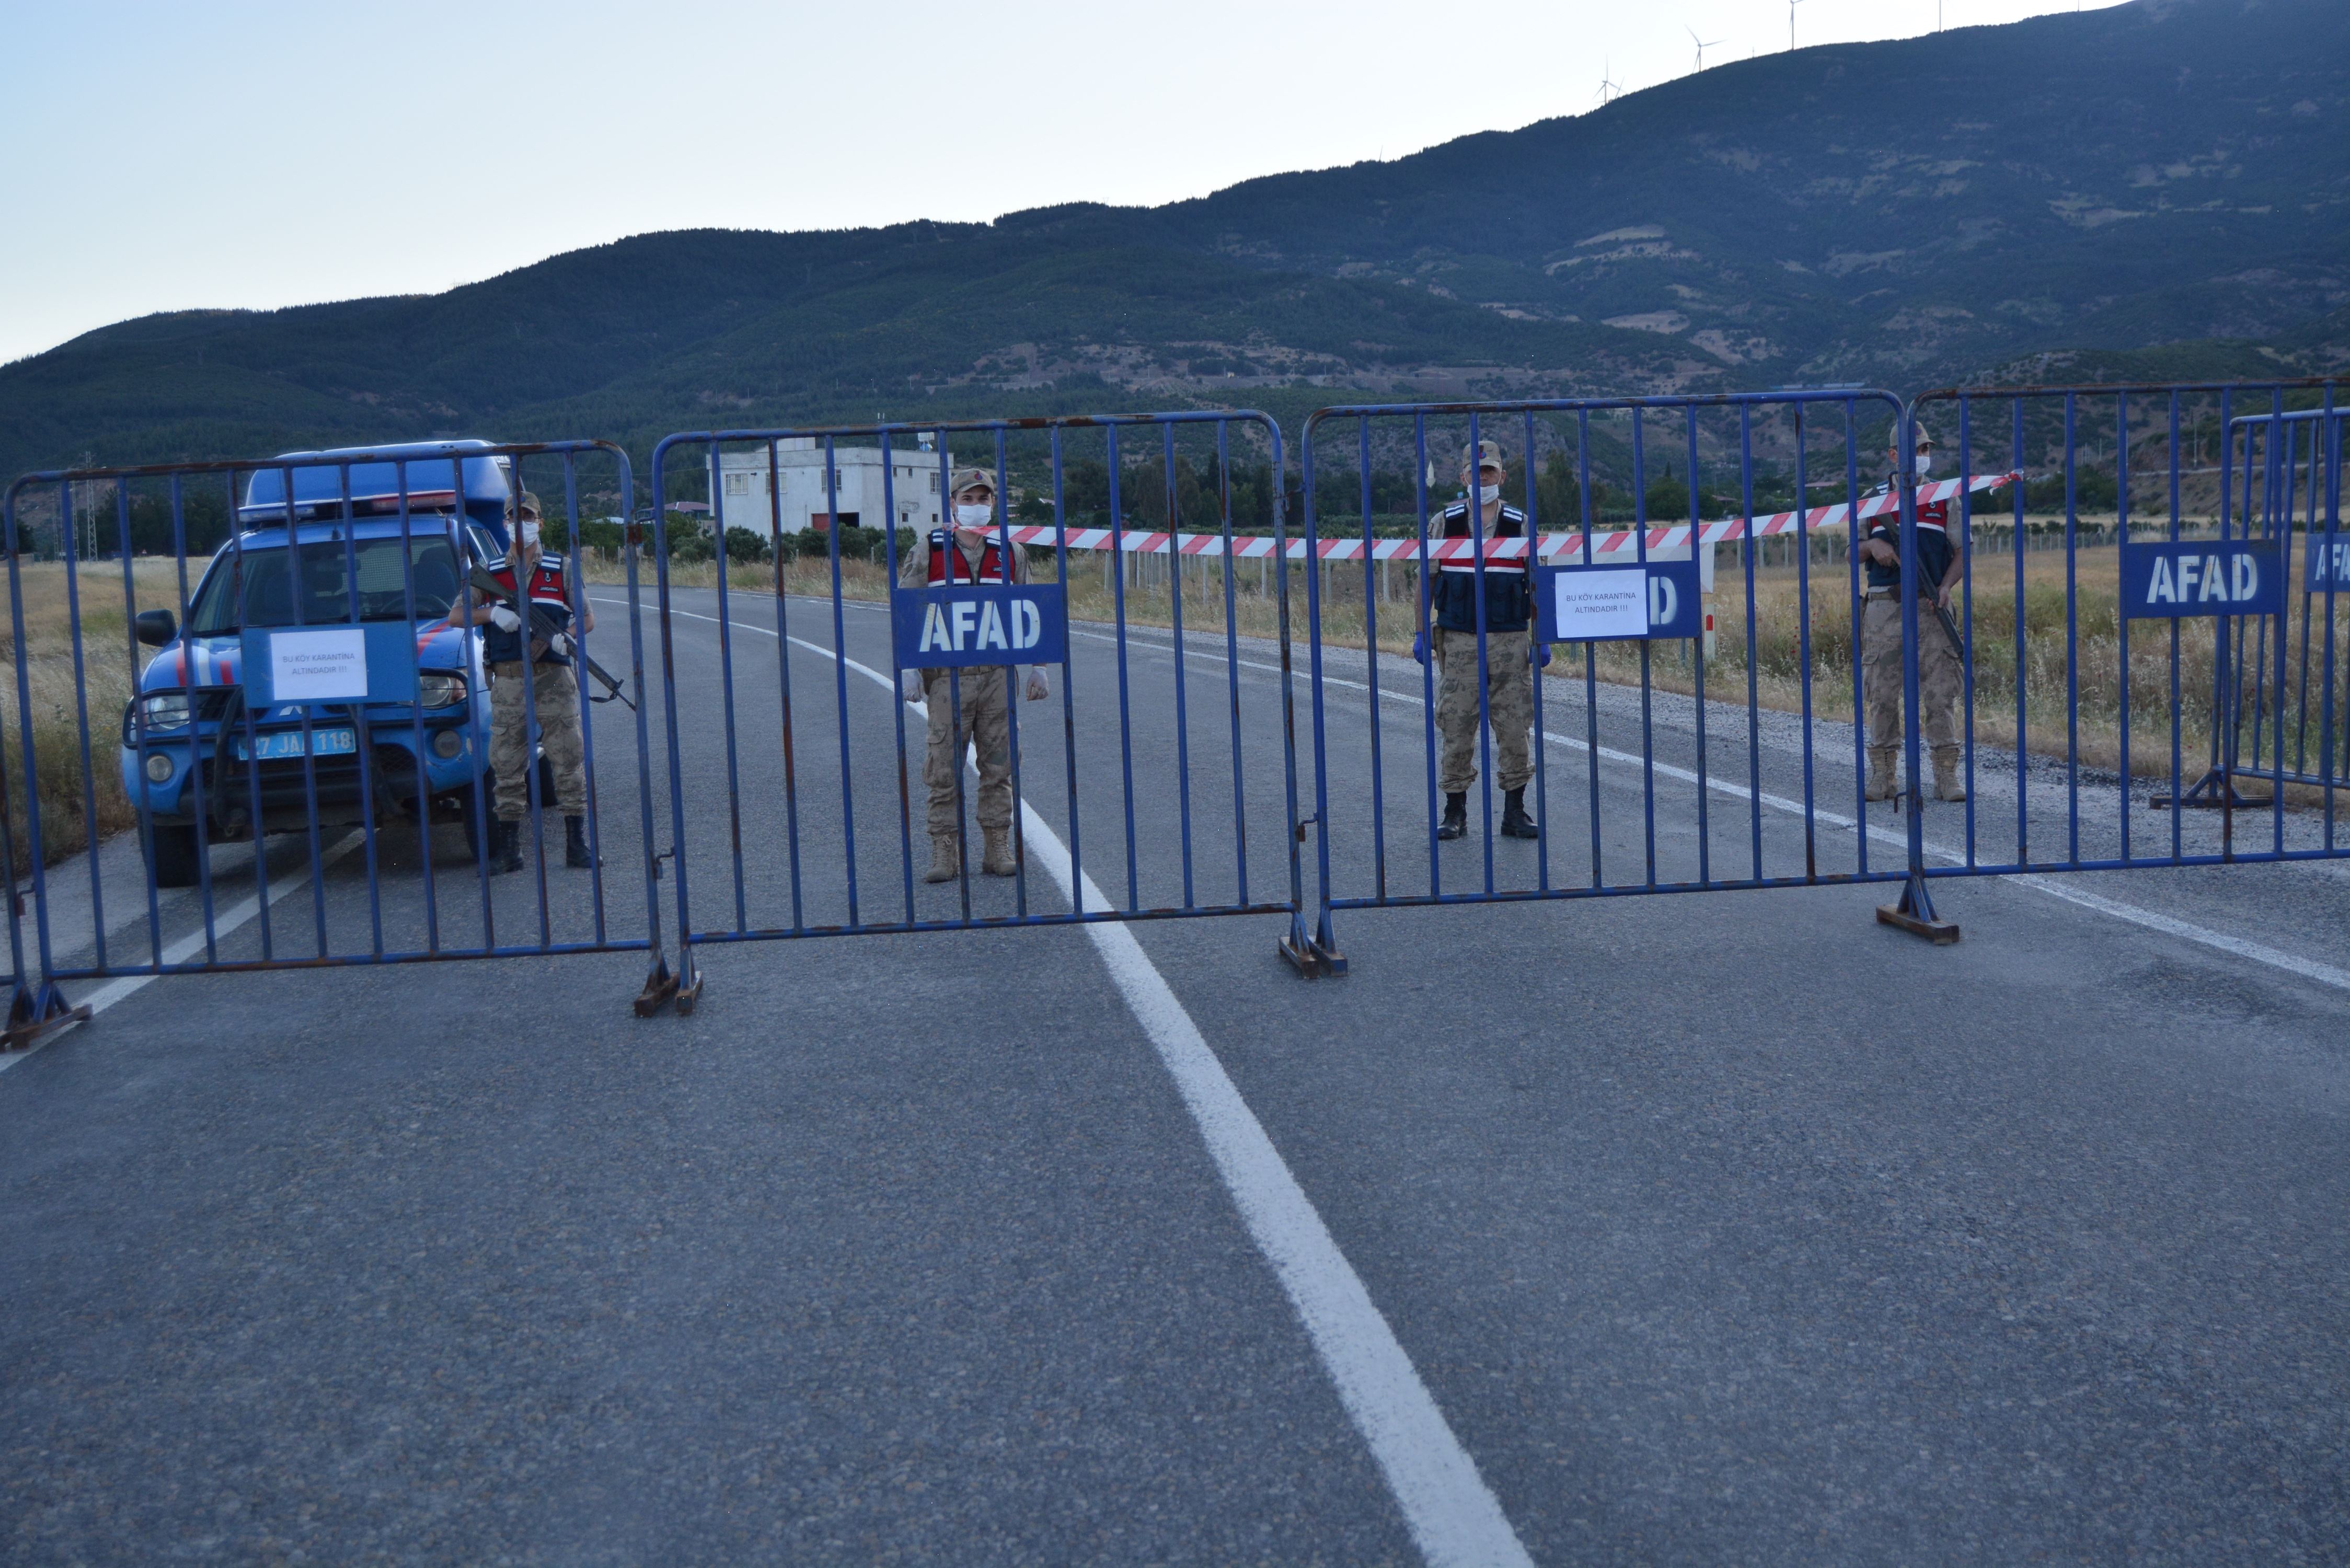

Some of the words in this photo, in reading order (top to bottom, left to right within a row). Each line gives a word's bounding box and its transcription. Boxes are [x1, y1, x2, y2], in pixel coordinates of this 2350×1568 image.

[2147, 554, 2257, 603] AFAD
[1595, 591, 1636, 600] KARANTİNA
[919, 599, 1041, 652] AFAD
[295, 653, 310, 662] KÖY
[312, 652, 355, 661] KARANTİNA
[292, 666, 337, 675] ALTINDADIR
[279, 734, 305, 753] JA
[319, 732, 351, 751] 118
